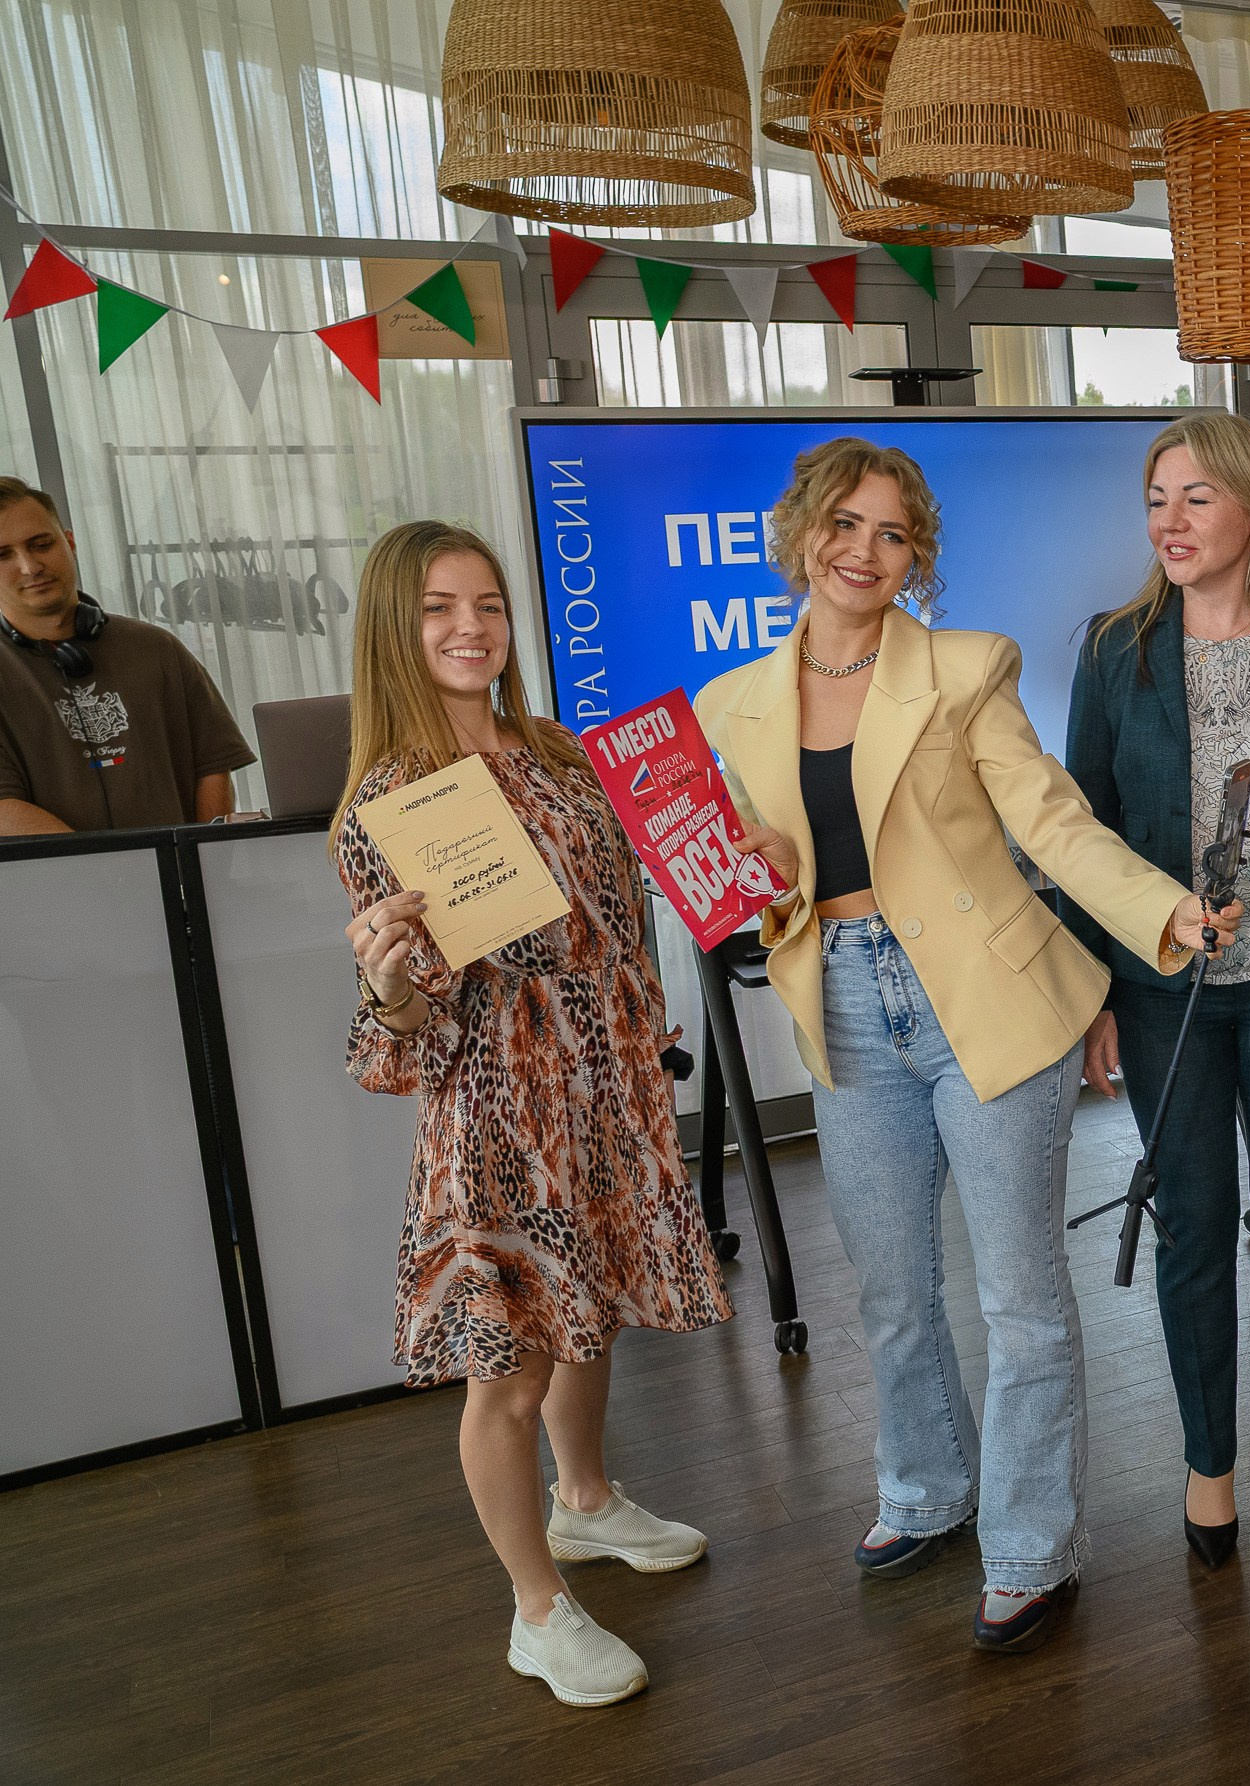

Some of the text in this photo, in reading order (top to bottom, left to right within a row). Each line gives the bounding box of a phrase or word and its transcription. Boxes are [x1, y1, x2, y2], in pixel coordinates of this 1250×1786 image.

[549, 457, 604, 658] РОССИИ
[596, 706, 676, 769] 1 МЕСТО
[653, 751, 686, 775] ОПОРА
[657, 760, 697, 789] РОССИИ
[644, 792, 697, 843] КОМАНДЕ,
[656, 799, 720, 862] КОТОРАЯ РАЗНЕСЛА
[415, 825, 494, 866] Подарочный
[426, 836, 499, 874] сертификат
[665, 812, 743, 923] ВСЕХ
[451, 873, 476, 890] 2000
